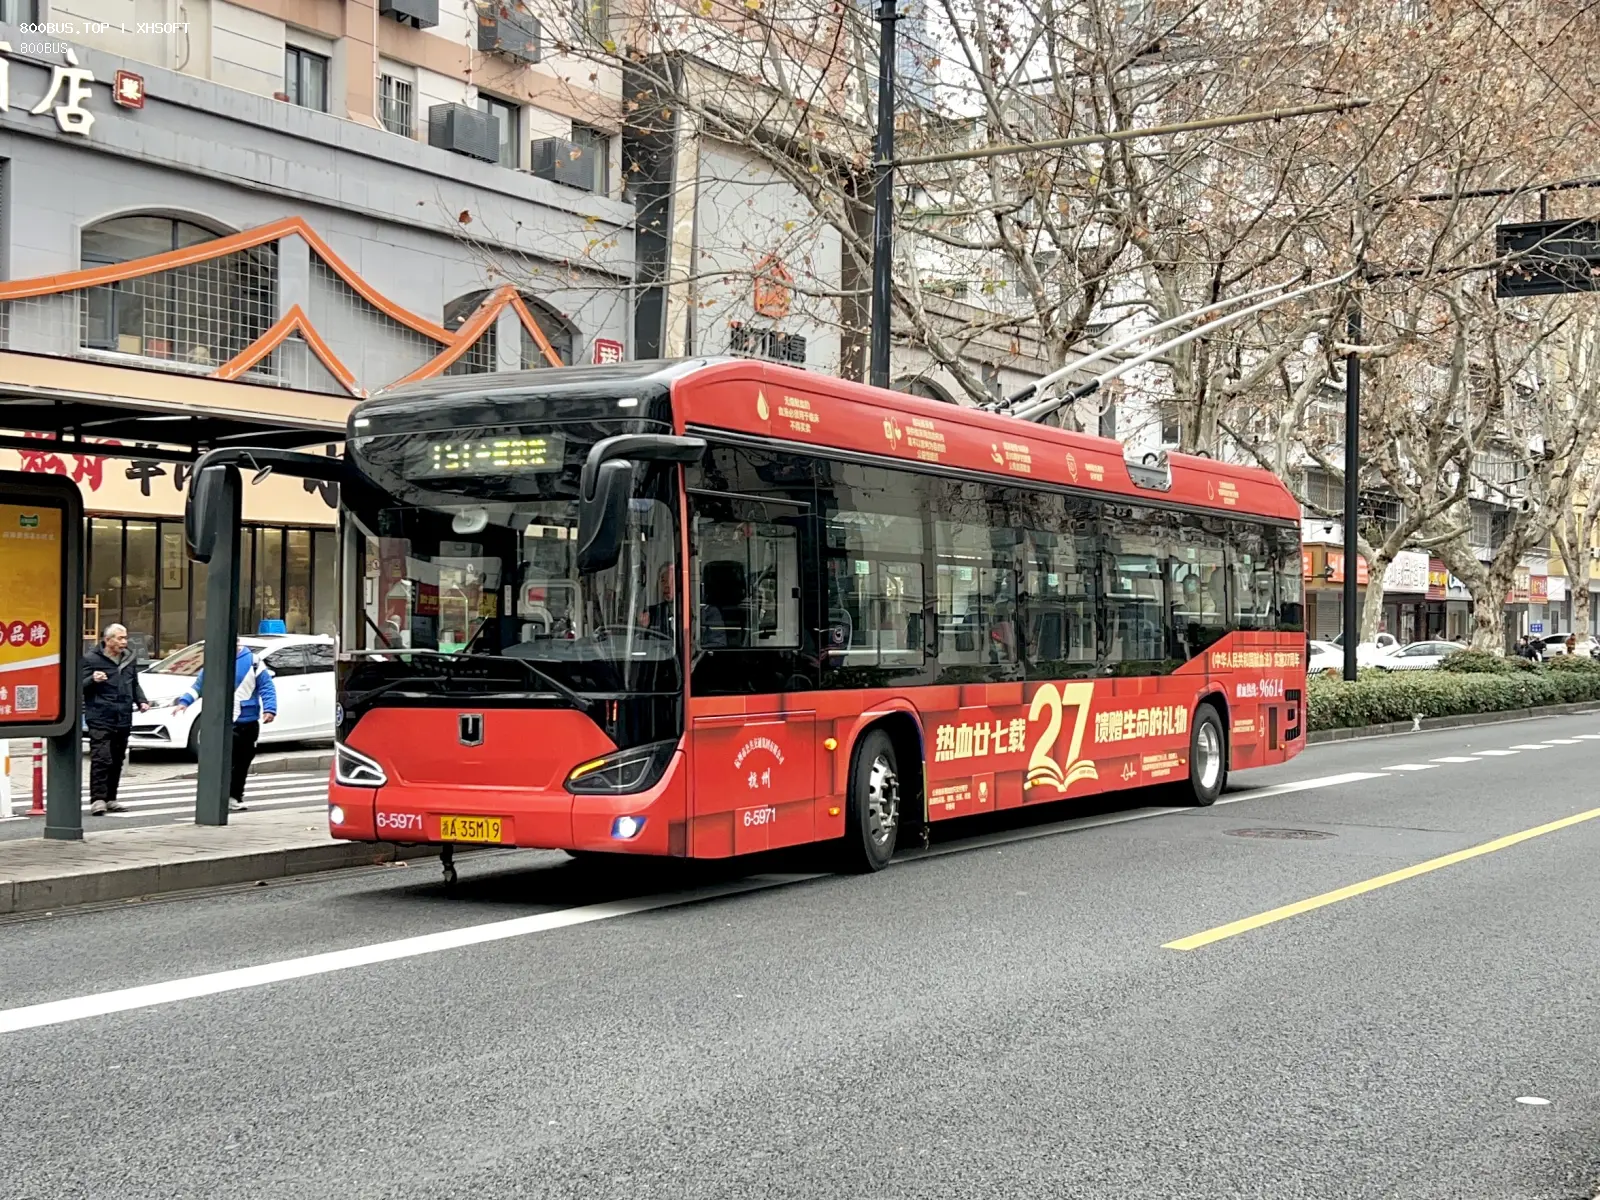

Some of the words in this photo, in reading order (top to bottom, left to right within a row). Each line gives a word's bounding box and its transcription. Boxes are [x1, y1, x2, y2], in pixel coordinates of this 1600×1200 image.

[0, 41, 95, 135] 店
[0, 622, 47, 645] 品牌
[1028, 682, 1095, 775] 27
[1094, 705, 1188, 743] 馈赠生命的礼物
[935, 718, 1026, 762] 热血廿七载
[748, 767, 771, 789] 杭州
[376, 812, 423, 830] 6-5971
[744, 807, 776, 827] 6-5971
